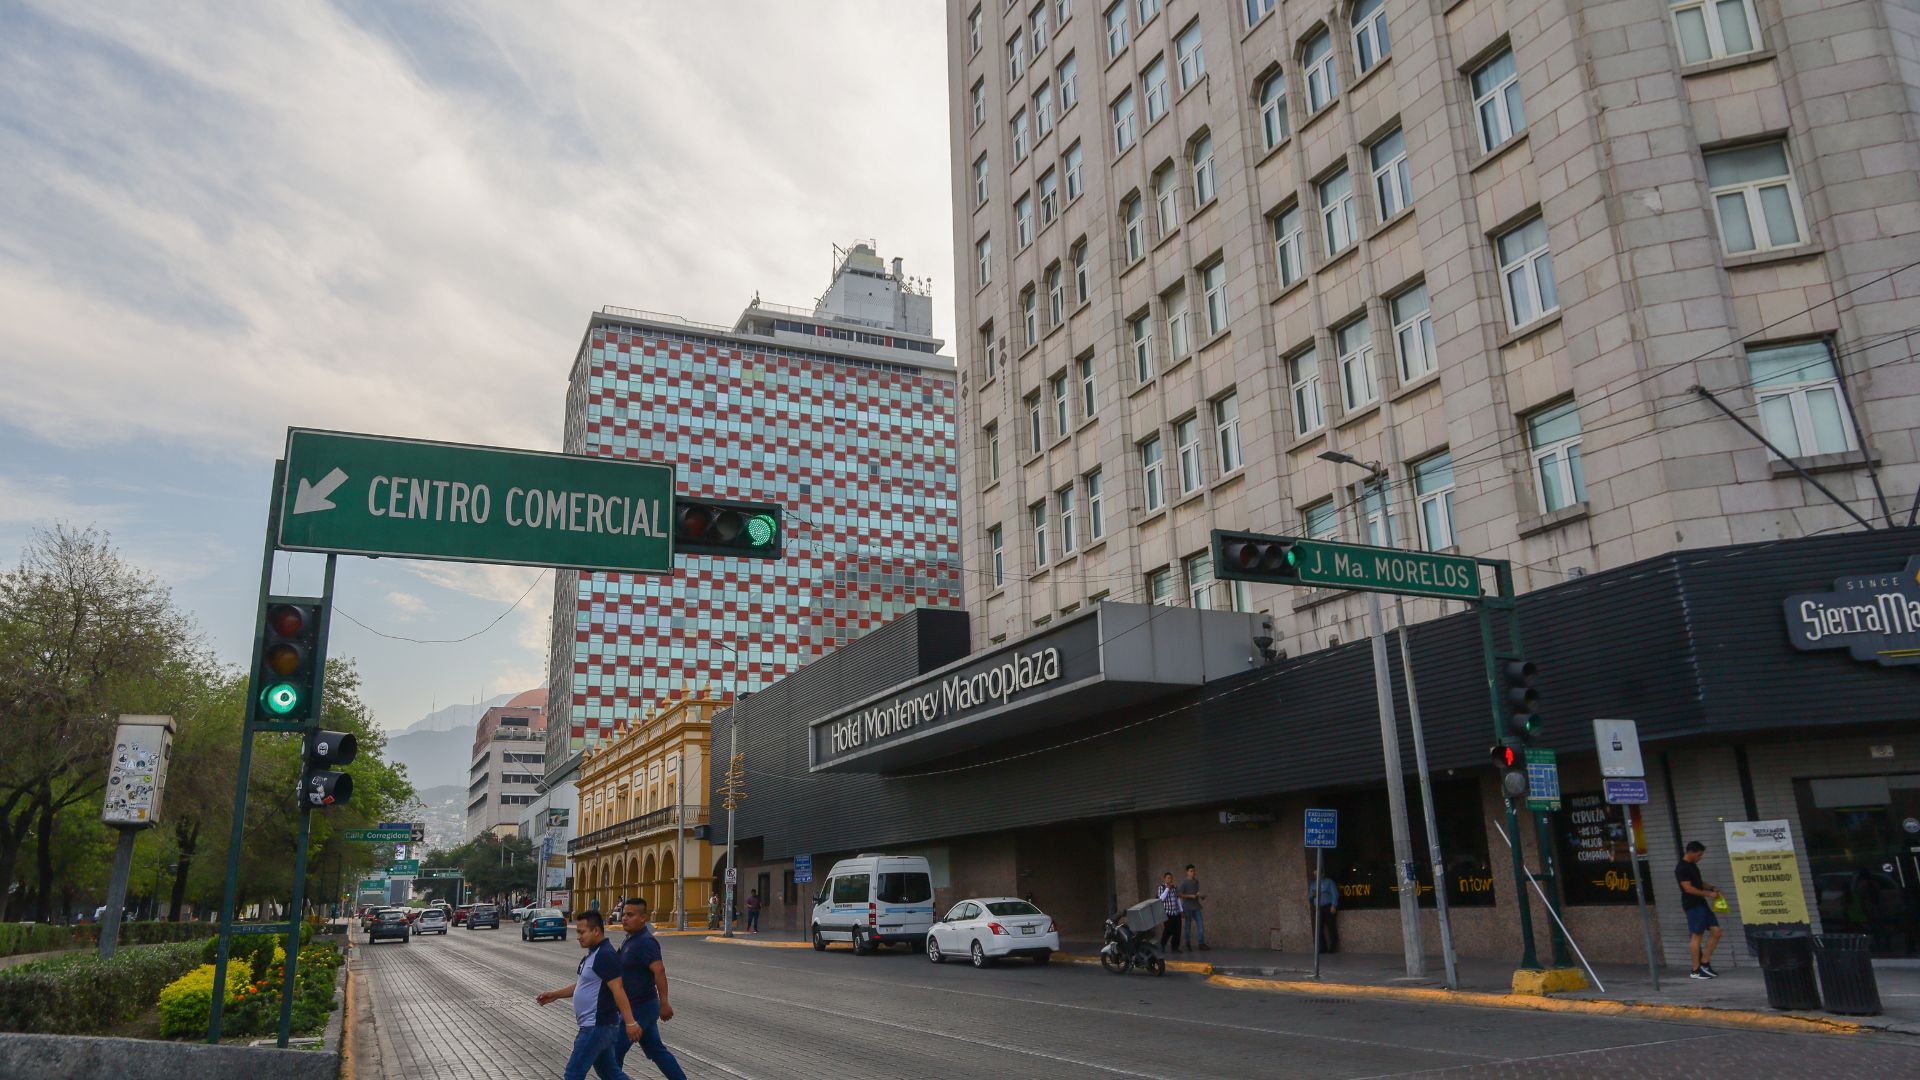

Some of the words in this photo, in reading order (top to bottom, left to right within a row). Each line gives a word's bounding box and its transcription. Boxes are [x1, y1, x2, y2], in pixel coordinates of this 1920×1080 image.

[368, 475, 491, 524] CENTRO
[505, 486, 668, 539] COMERCIAL
[1311, 550, 1328, 575] J.
[1334, 552, 1369, 579] Ma.
[1375, 557, 1470, 589] MORELOS
[1846, 577, 1900, 590] SINCE
[831, 714, 861, 754] Hotel
[865, 688, 940, 742] Monterrey
[943, 647, 1061, 716] Macroplaza
[1571, 809, 1605, 824] CERVEZA
[366, 831, 409, 840] Corregidora
[1749, 863, 1782, 873] ¡ESTAMOS
[1742, 874, 1792, 883] CONTRATANDO!
